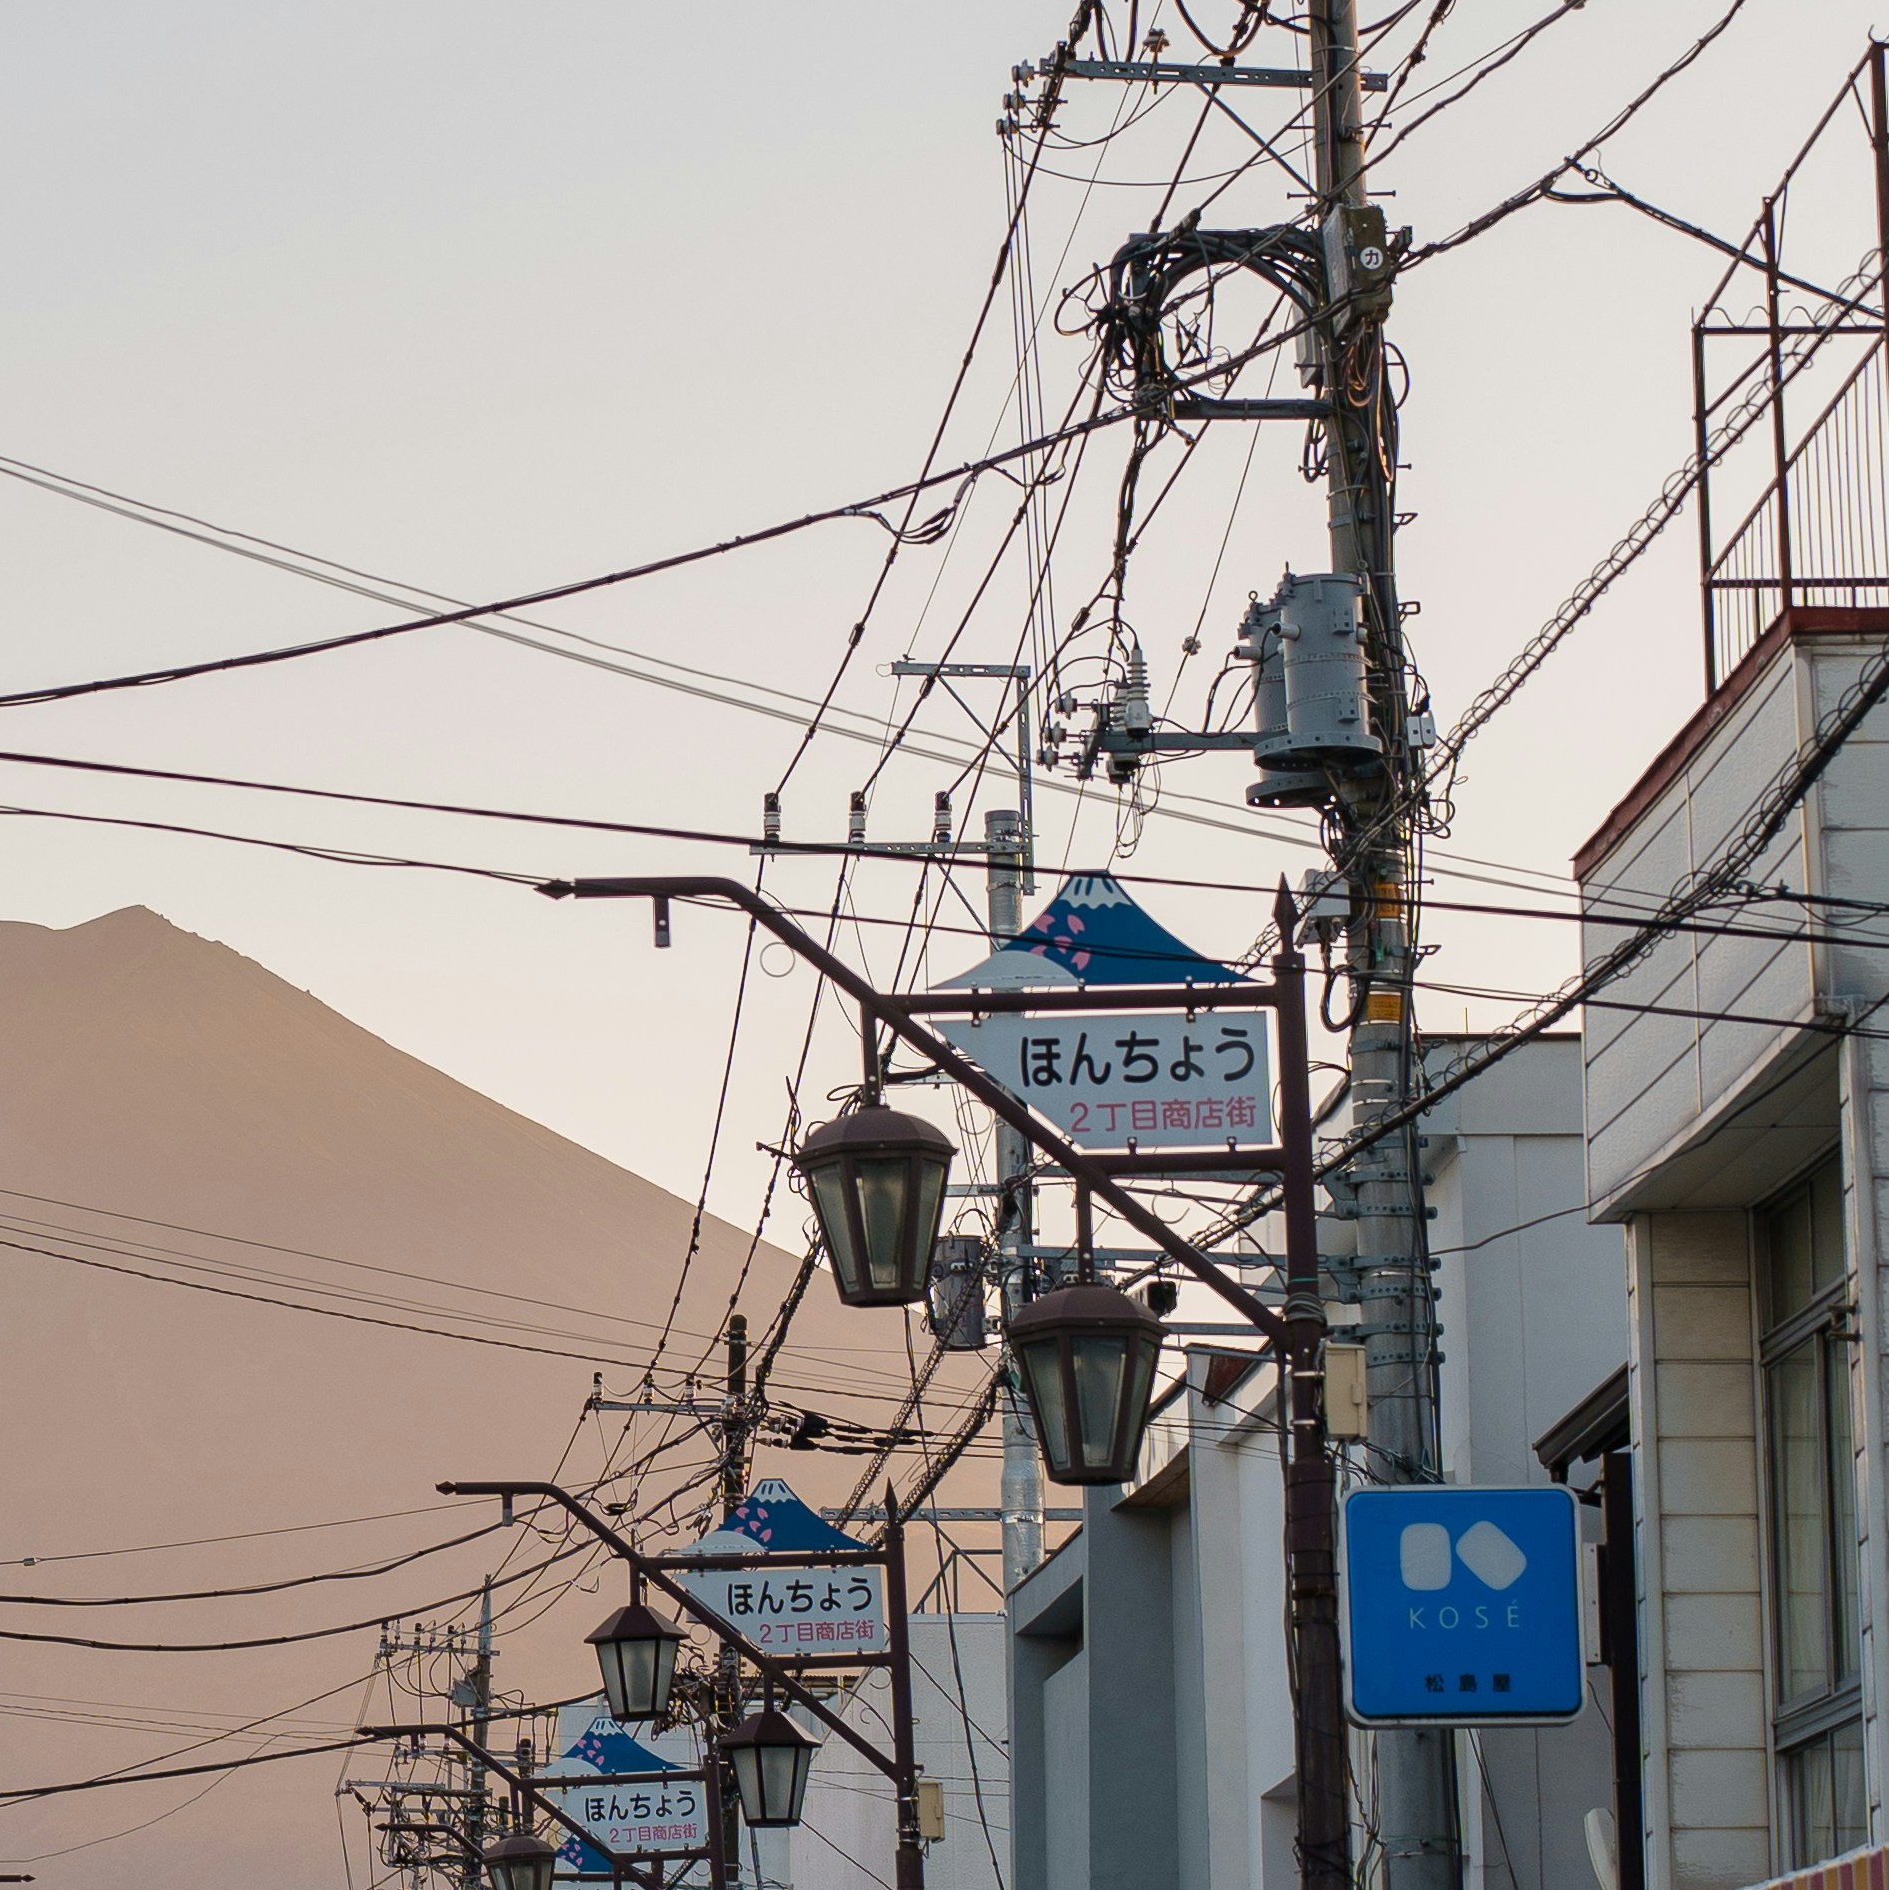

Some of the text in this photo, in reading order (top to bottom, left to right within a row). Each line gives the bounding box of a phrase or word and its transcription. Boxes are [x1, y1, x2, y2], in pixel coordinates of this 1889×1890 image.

[1020, 1027, 1255, 1087] ほんちょう
[1070, 1097, 1256, 1133] 2丁目商店街
[727, 1577, 873, 1615] ほんちょう
[1409, 1599, 1521, 1630] KOSÉ
[760, 1620, 875, 1644] 2丁目商店街
[1425, 1673, 1512, 1694] 松島屋
[585, 1789, 697, 1822] ほんちょう
[610, 1824, 698, 1843] 2丁目商店街
